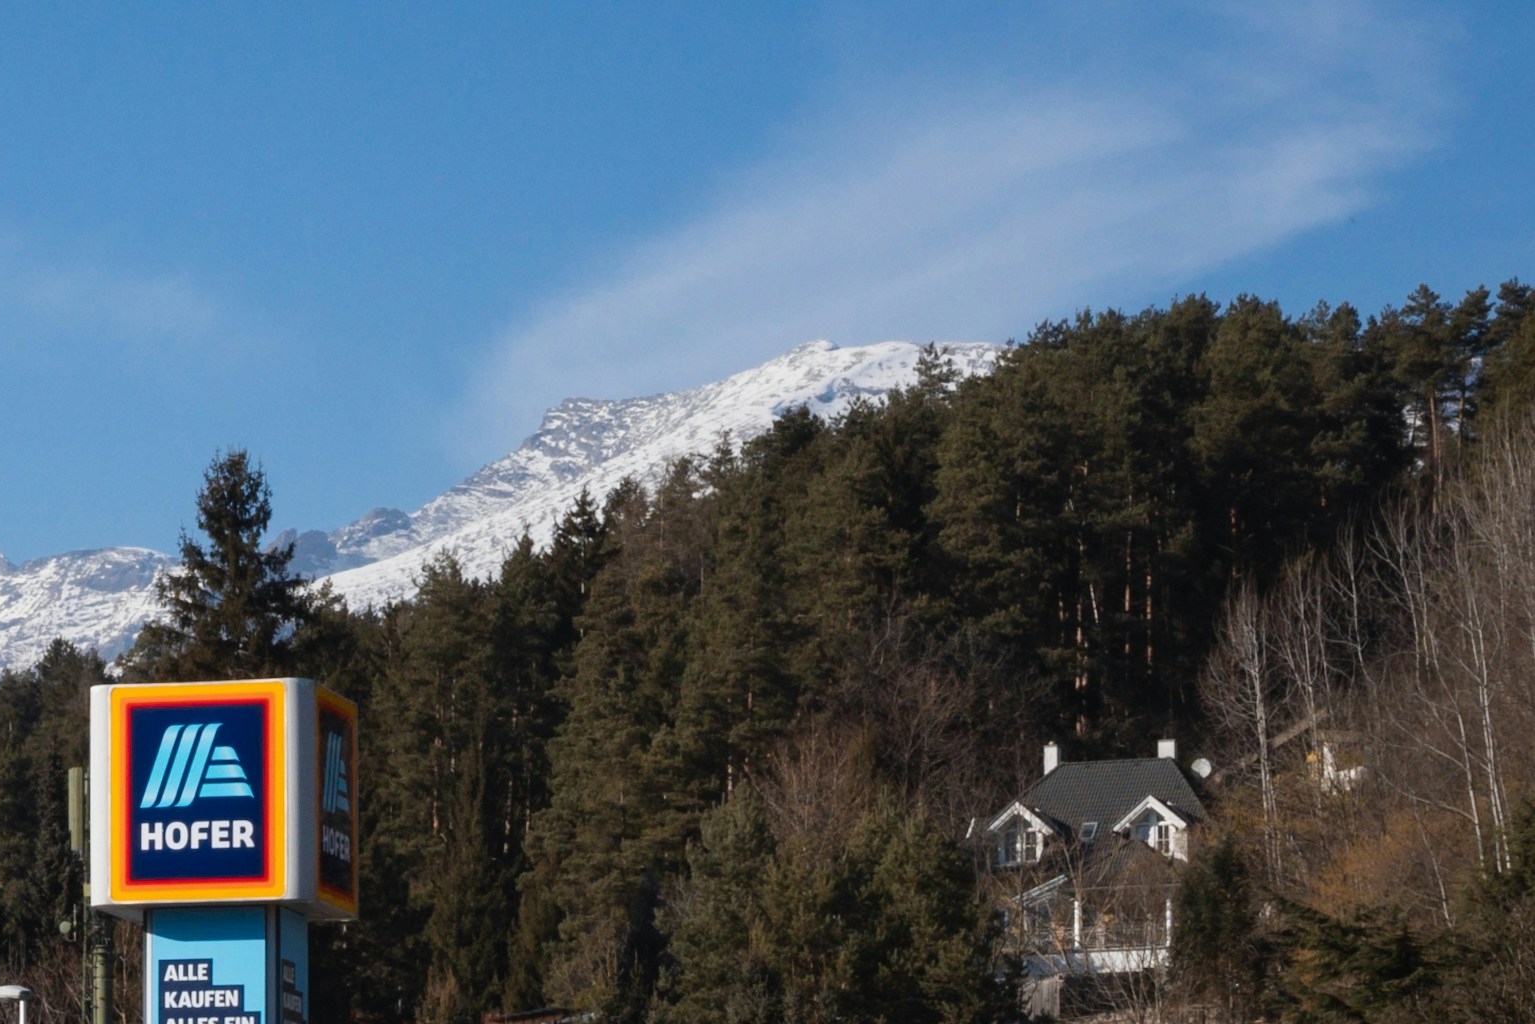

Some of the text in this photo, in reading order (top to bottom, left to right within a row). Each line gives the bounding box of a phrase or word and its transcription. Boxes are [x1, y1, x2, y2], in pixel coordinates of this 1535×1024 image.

[140, 820, 255, 851] HOFER
[322, 825, 351, 863] HOFER
[164, 964, 209, 982] ALLE
[164, 990, 239, 1008] KAUFEN
